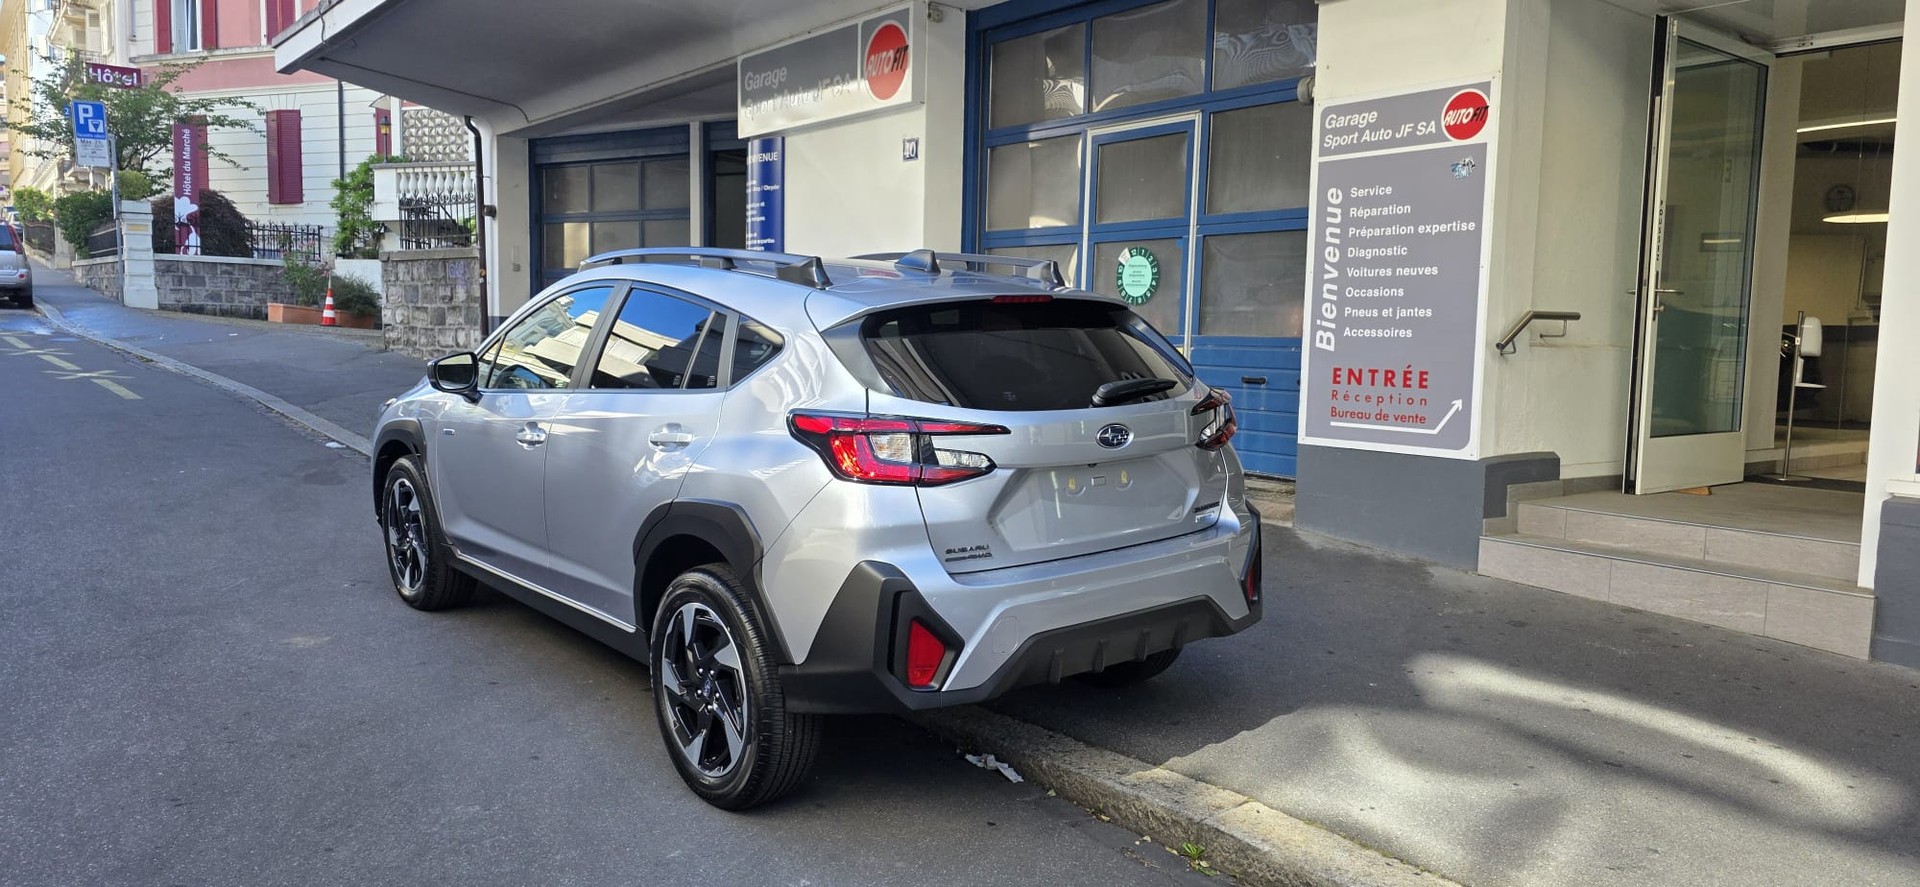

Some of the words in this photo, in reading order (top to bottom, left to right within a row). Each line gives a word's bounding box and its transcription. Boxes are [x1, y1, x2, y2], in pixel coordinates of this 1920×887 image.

[866, 45, 909, 77] AUTOFIT
[89, 67, 137, 86] Hôtel
[744, 66, 788, 91] Garage
[78, 104, 93, 125] P
[1325, 111, 1378, 129] Garage
[1444, 105, 1490, 126] AUTOFIT
[182, 128, 191, 160] Marché
[1323, 132, 1359, 149] Sport
[1360, 128, 1393, 143] Auto
[1395, 123, 1414, 138] JF
[1416, 121, 1437, 136] SA
[182, 161, 191, 172] du
[182, 173, 192, 196] Hôtel
[1350, 185, 1392, 197] Service
[1350, 204, 1411, 219] Réparation
[1348, 224, 1414, 238] Préparation
[1418, 221, 1476, 235] expertise
[1347, 245, 1408, 259] Diagnostic
[1315, 187, 1343, 351] Bienvenue
[1346, 267, 1392, 277] Voitures
[1396, 266, 1438, 276] neuves
[1345, 286, 1404, 297] Occasions
[1344, 306, 1379, 317] Pneus
[1382, 307, 1393, 317] et
[1396, 306, 1433, 319] jantes
[1343, 327, 1413, 338] Accessoires
[1332, 364, 1429, 389] ENTRÉE
[1331, 390, 1428, 406] Réception
[1330, 406, 1371, 420] Bureau
[1374, 409, 1389, 421] de
[1393, 413, 1426, 424] vente
[945, 544, 990, 554] SUBARU
